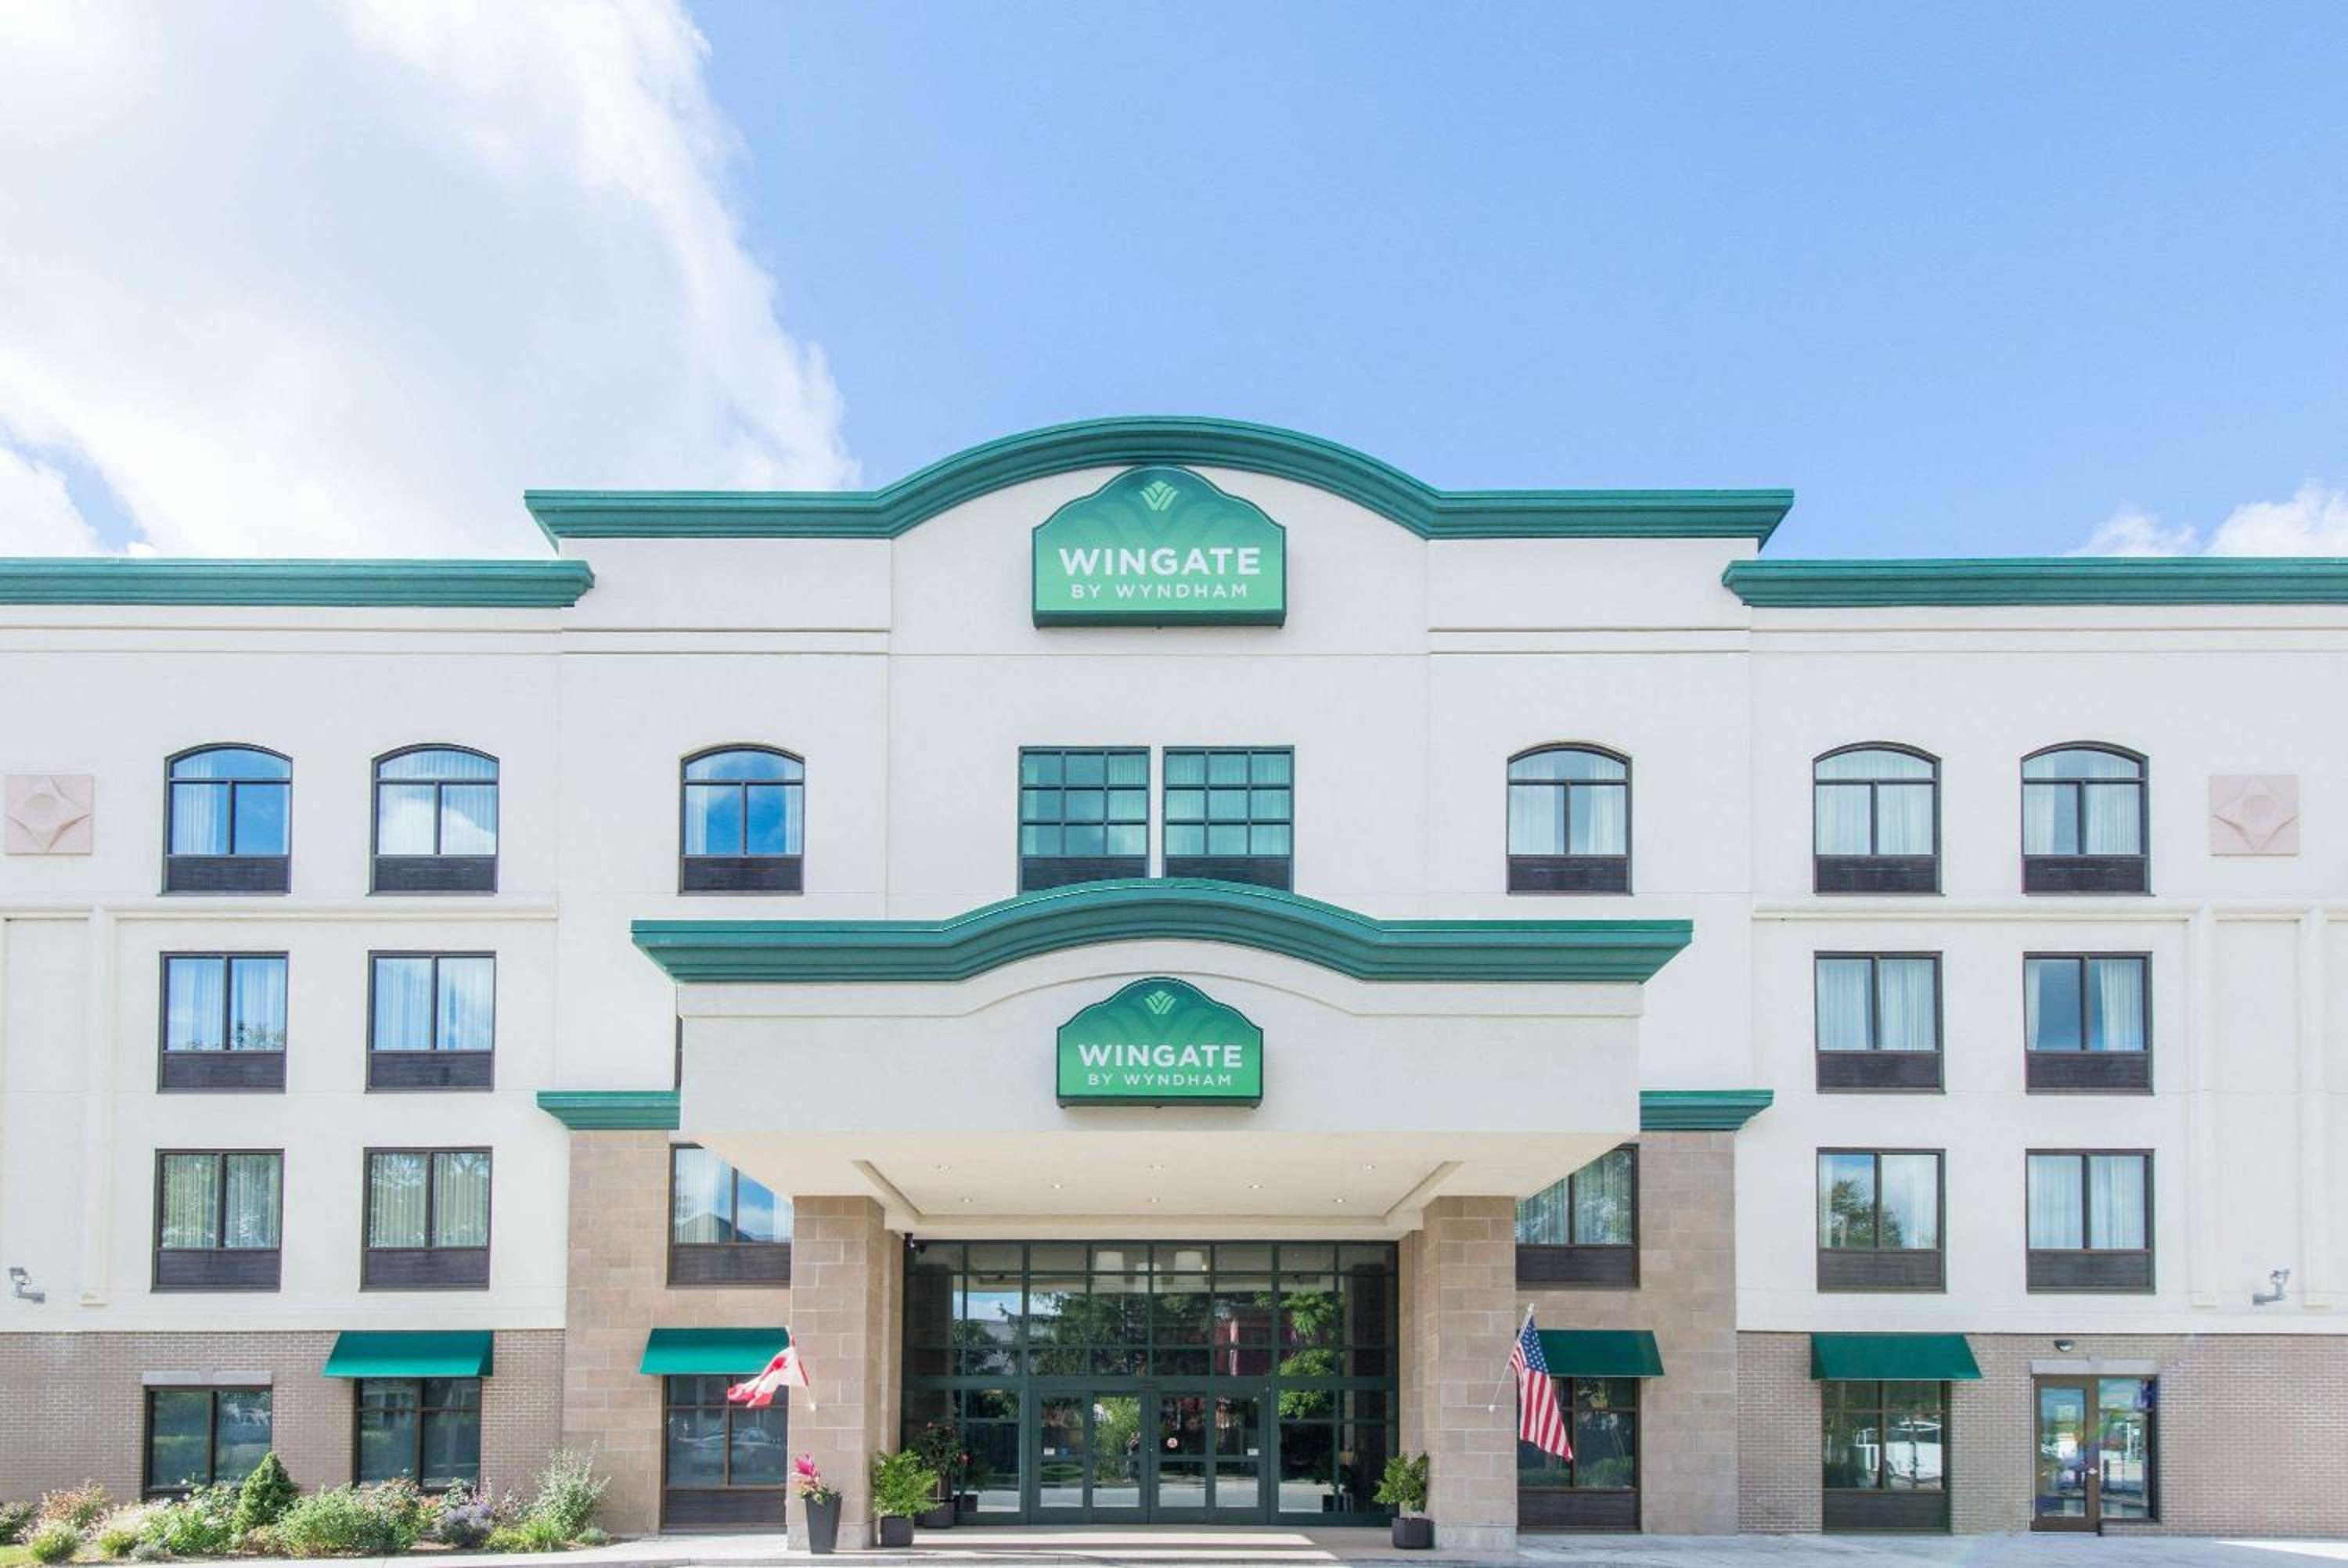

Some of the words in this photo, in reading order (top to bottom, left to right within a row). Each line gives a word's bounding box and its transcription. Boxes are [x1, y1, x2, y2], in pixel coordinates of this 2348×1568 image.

[1058, 548, 1261, 576] WINGATE
[1071, 584, 1102, 599] BY
[1115, 584, 1248, 599] WYNDHAM
[1078, 1045, 1243, 1068] WINGATE
[1088, 1074, 1113, 1085] BY
[1124, 1074, 1232, 1085] WYNDHAM
